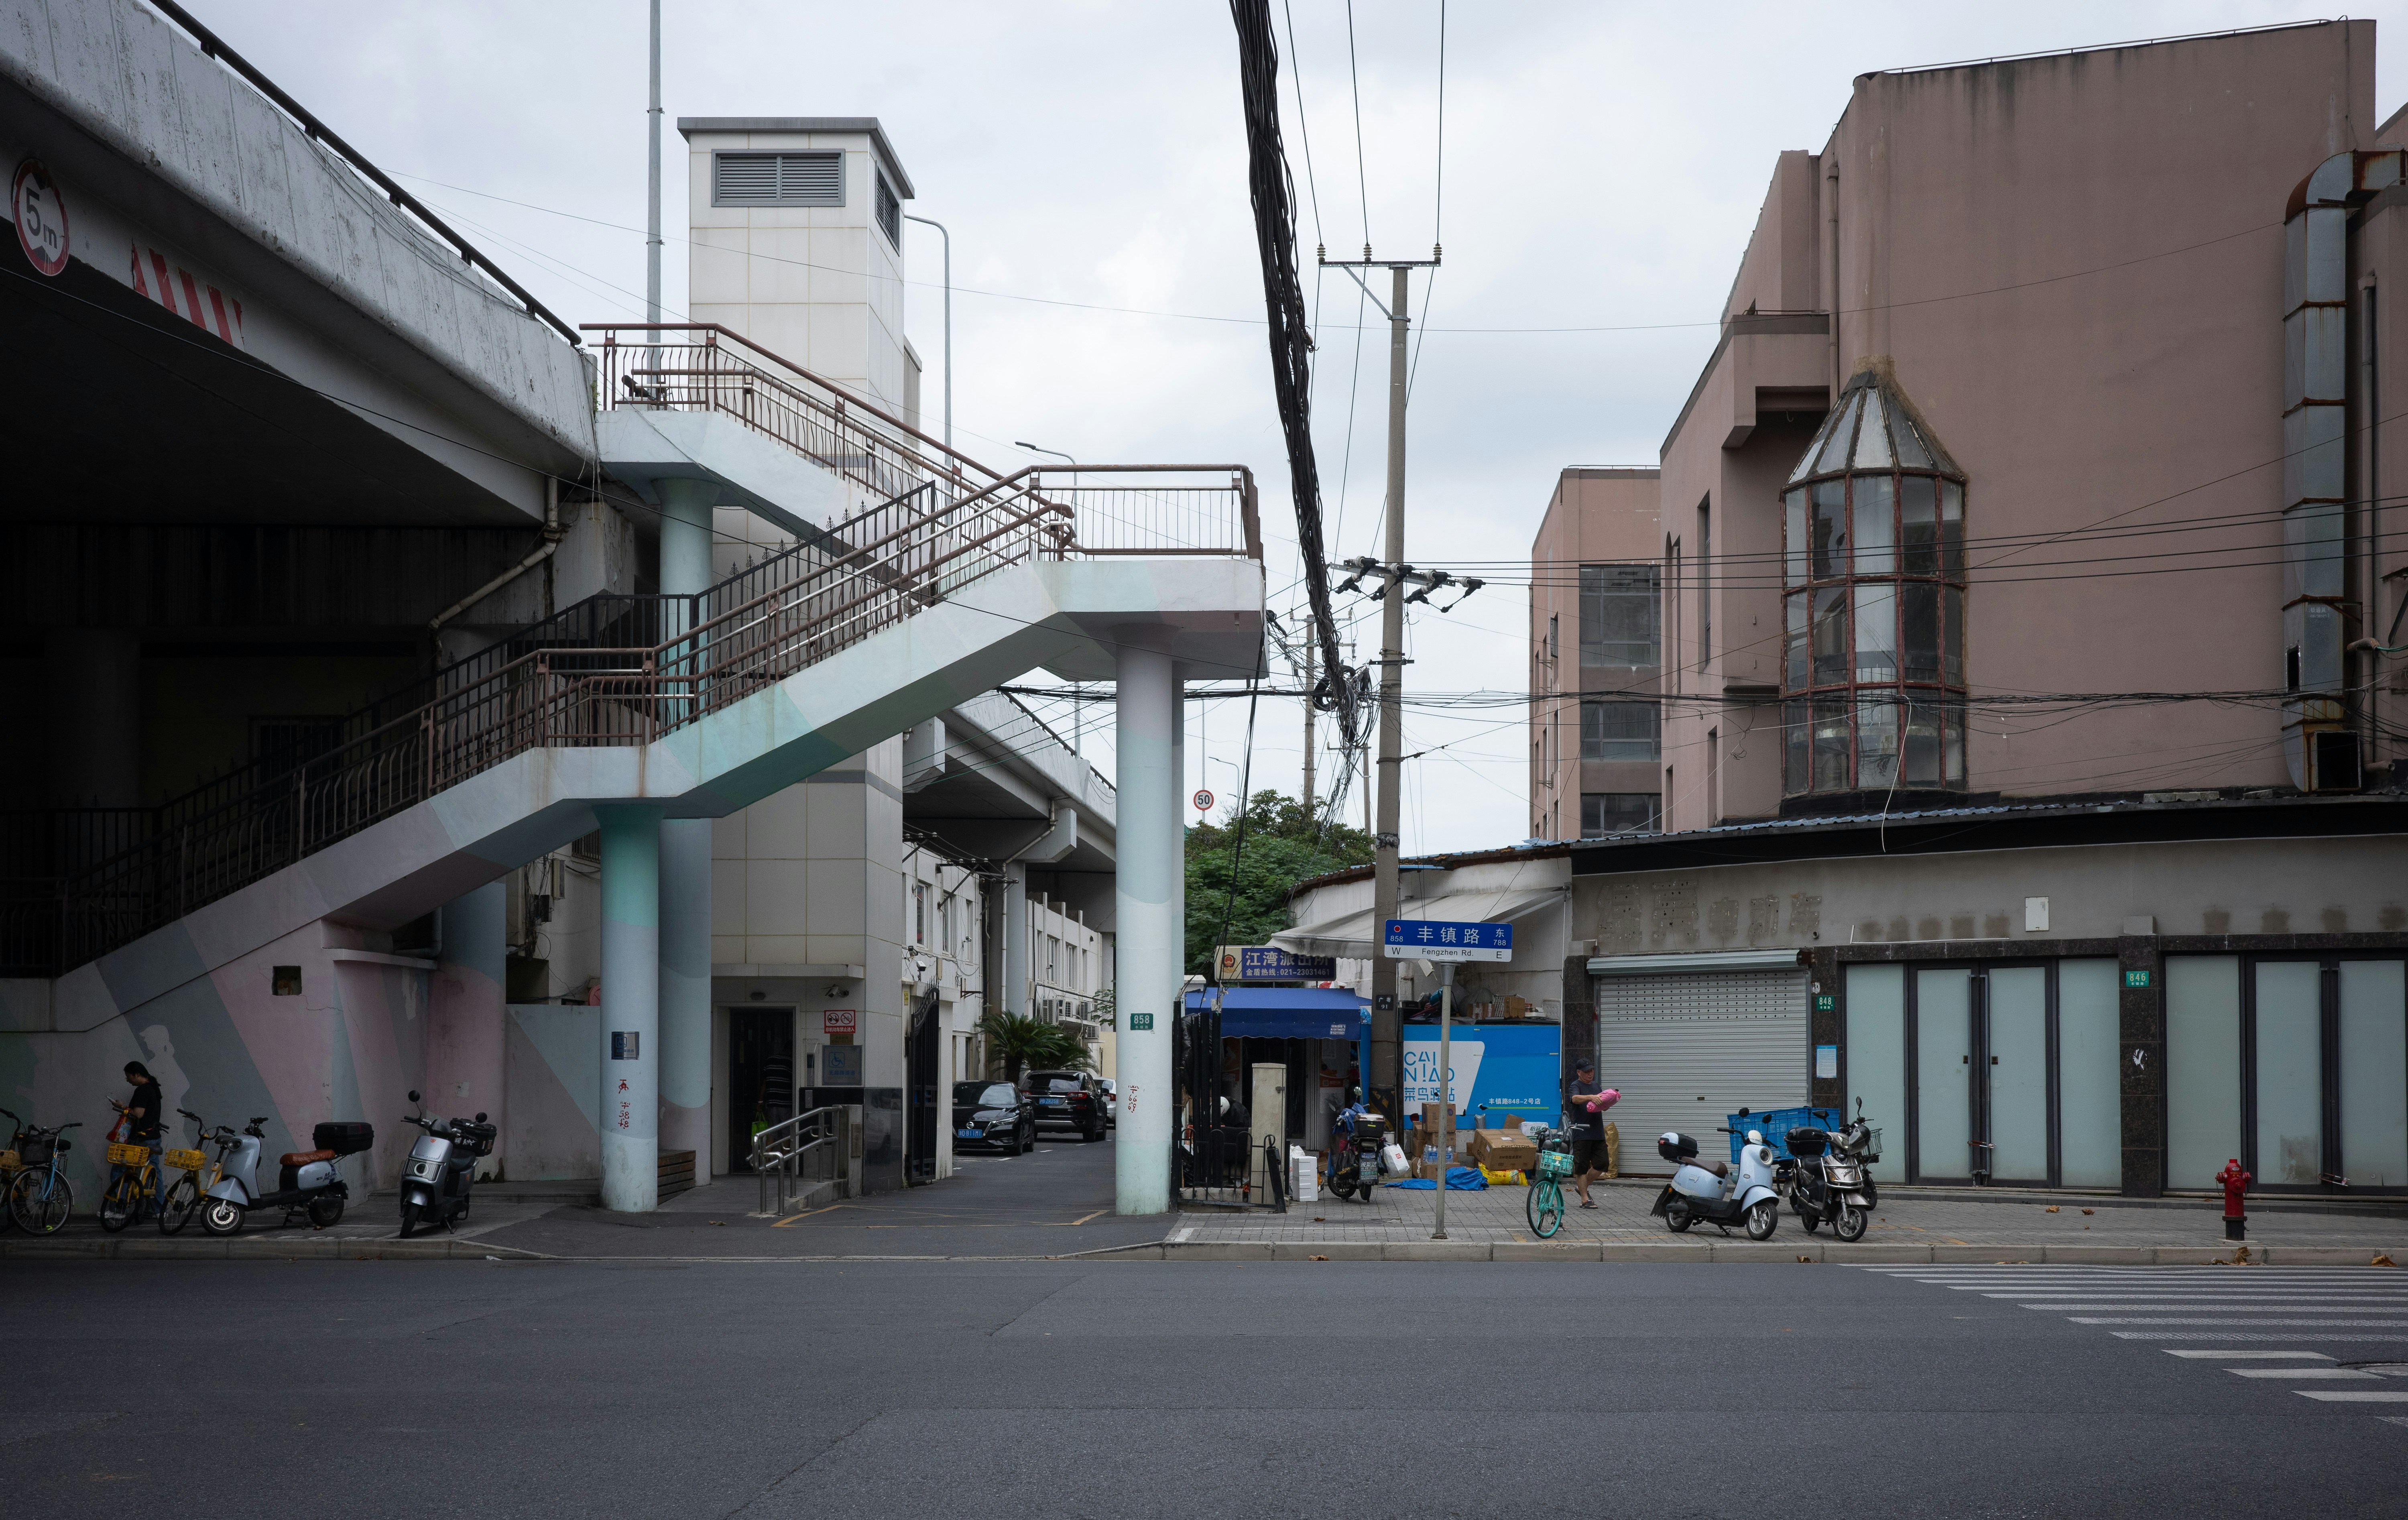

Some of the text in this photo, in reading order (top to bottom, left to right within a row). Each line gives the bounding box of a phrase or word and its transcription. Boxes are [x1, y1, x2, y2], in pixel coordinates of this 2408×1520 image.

[1198, 795, 1210, 805] 50
[1417, 926, 1480, 944] 丰镇路
[1495, 928, 1504, 938] 东
[1422, 948, 1458, 956] Fengzhen
[1246, 951, 1328, 967] 江湾派出所
[2129, 973, 2146, 981] 846
[1819, 997, 1832, 1005] 848
[1133, 1015, 1150, 1024] 858
